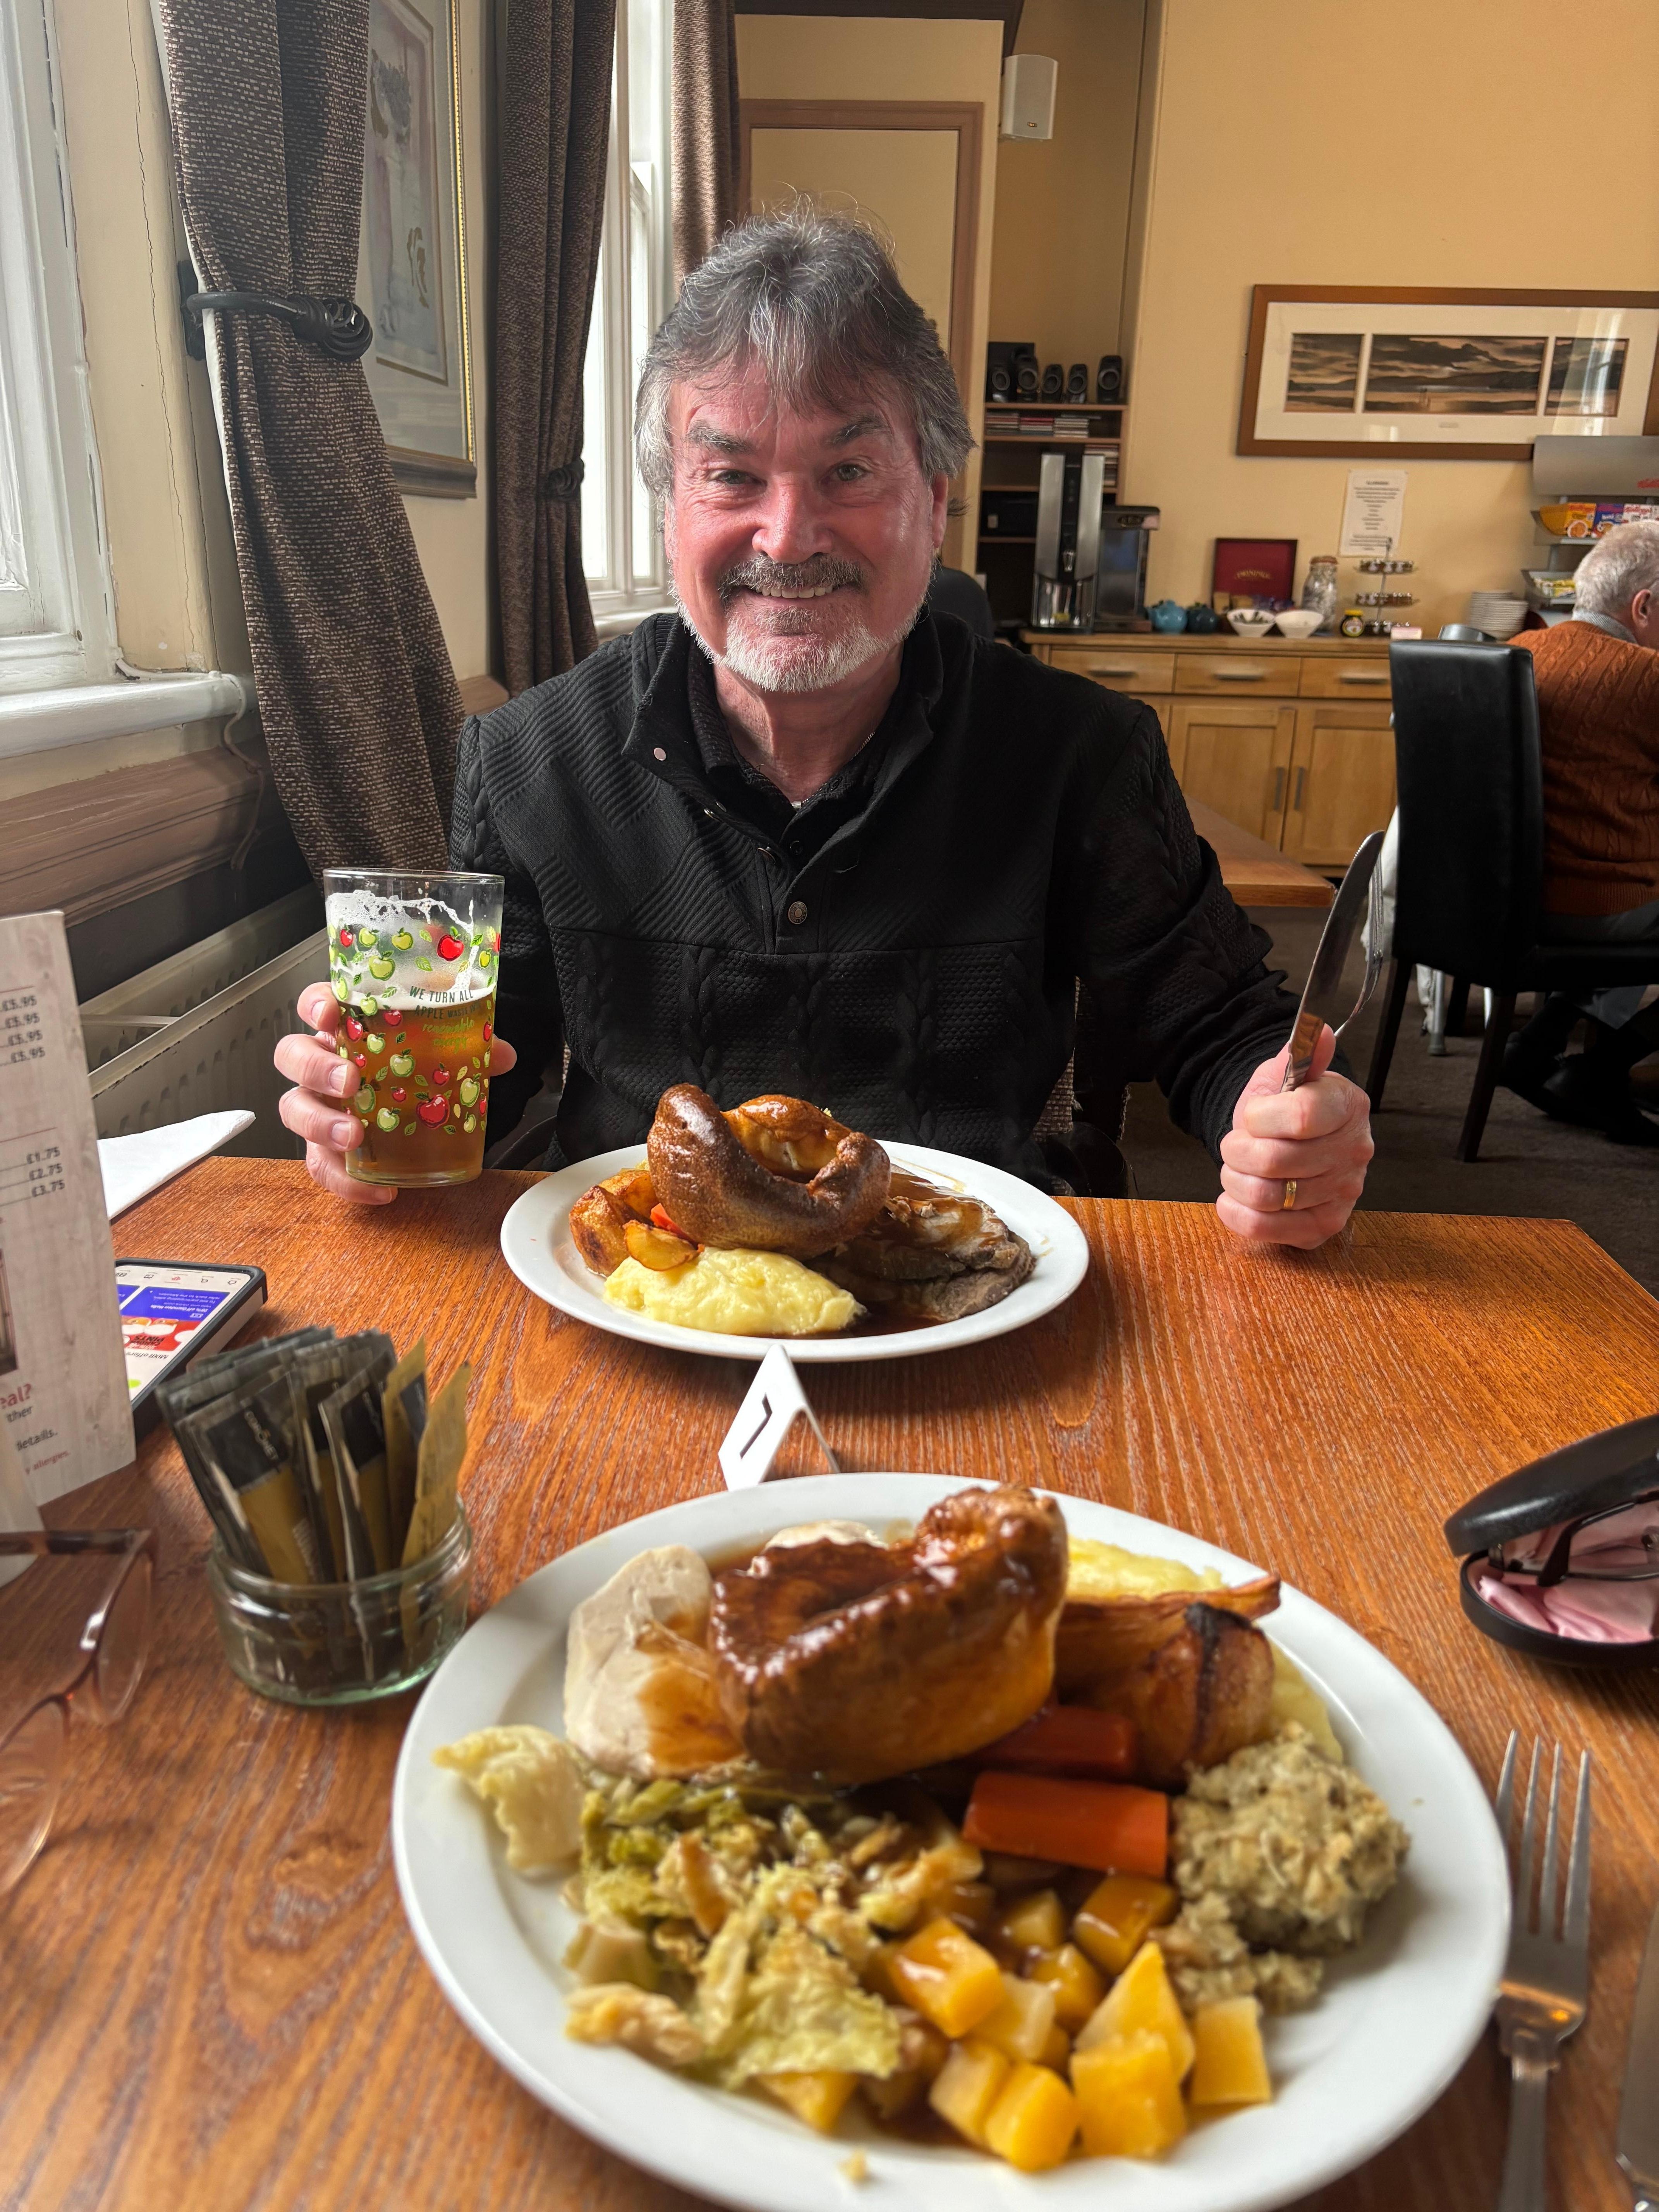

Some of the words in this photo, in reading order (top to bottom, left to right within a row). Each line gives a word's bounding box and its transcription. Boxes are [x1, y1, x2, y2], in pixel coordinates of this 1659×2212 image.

[410, 986, 425, 1000] WE
[429, 991, 455, 1003] TURN
[460, 990, 473, 1002] ALL
[416, 1005, 443, 1019] APPLE
